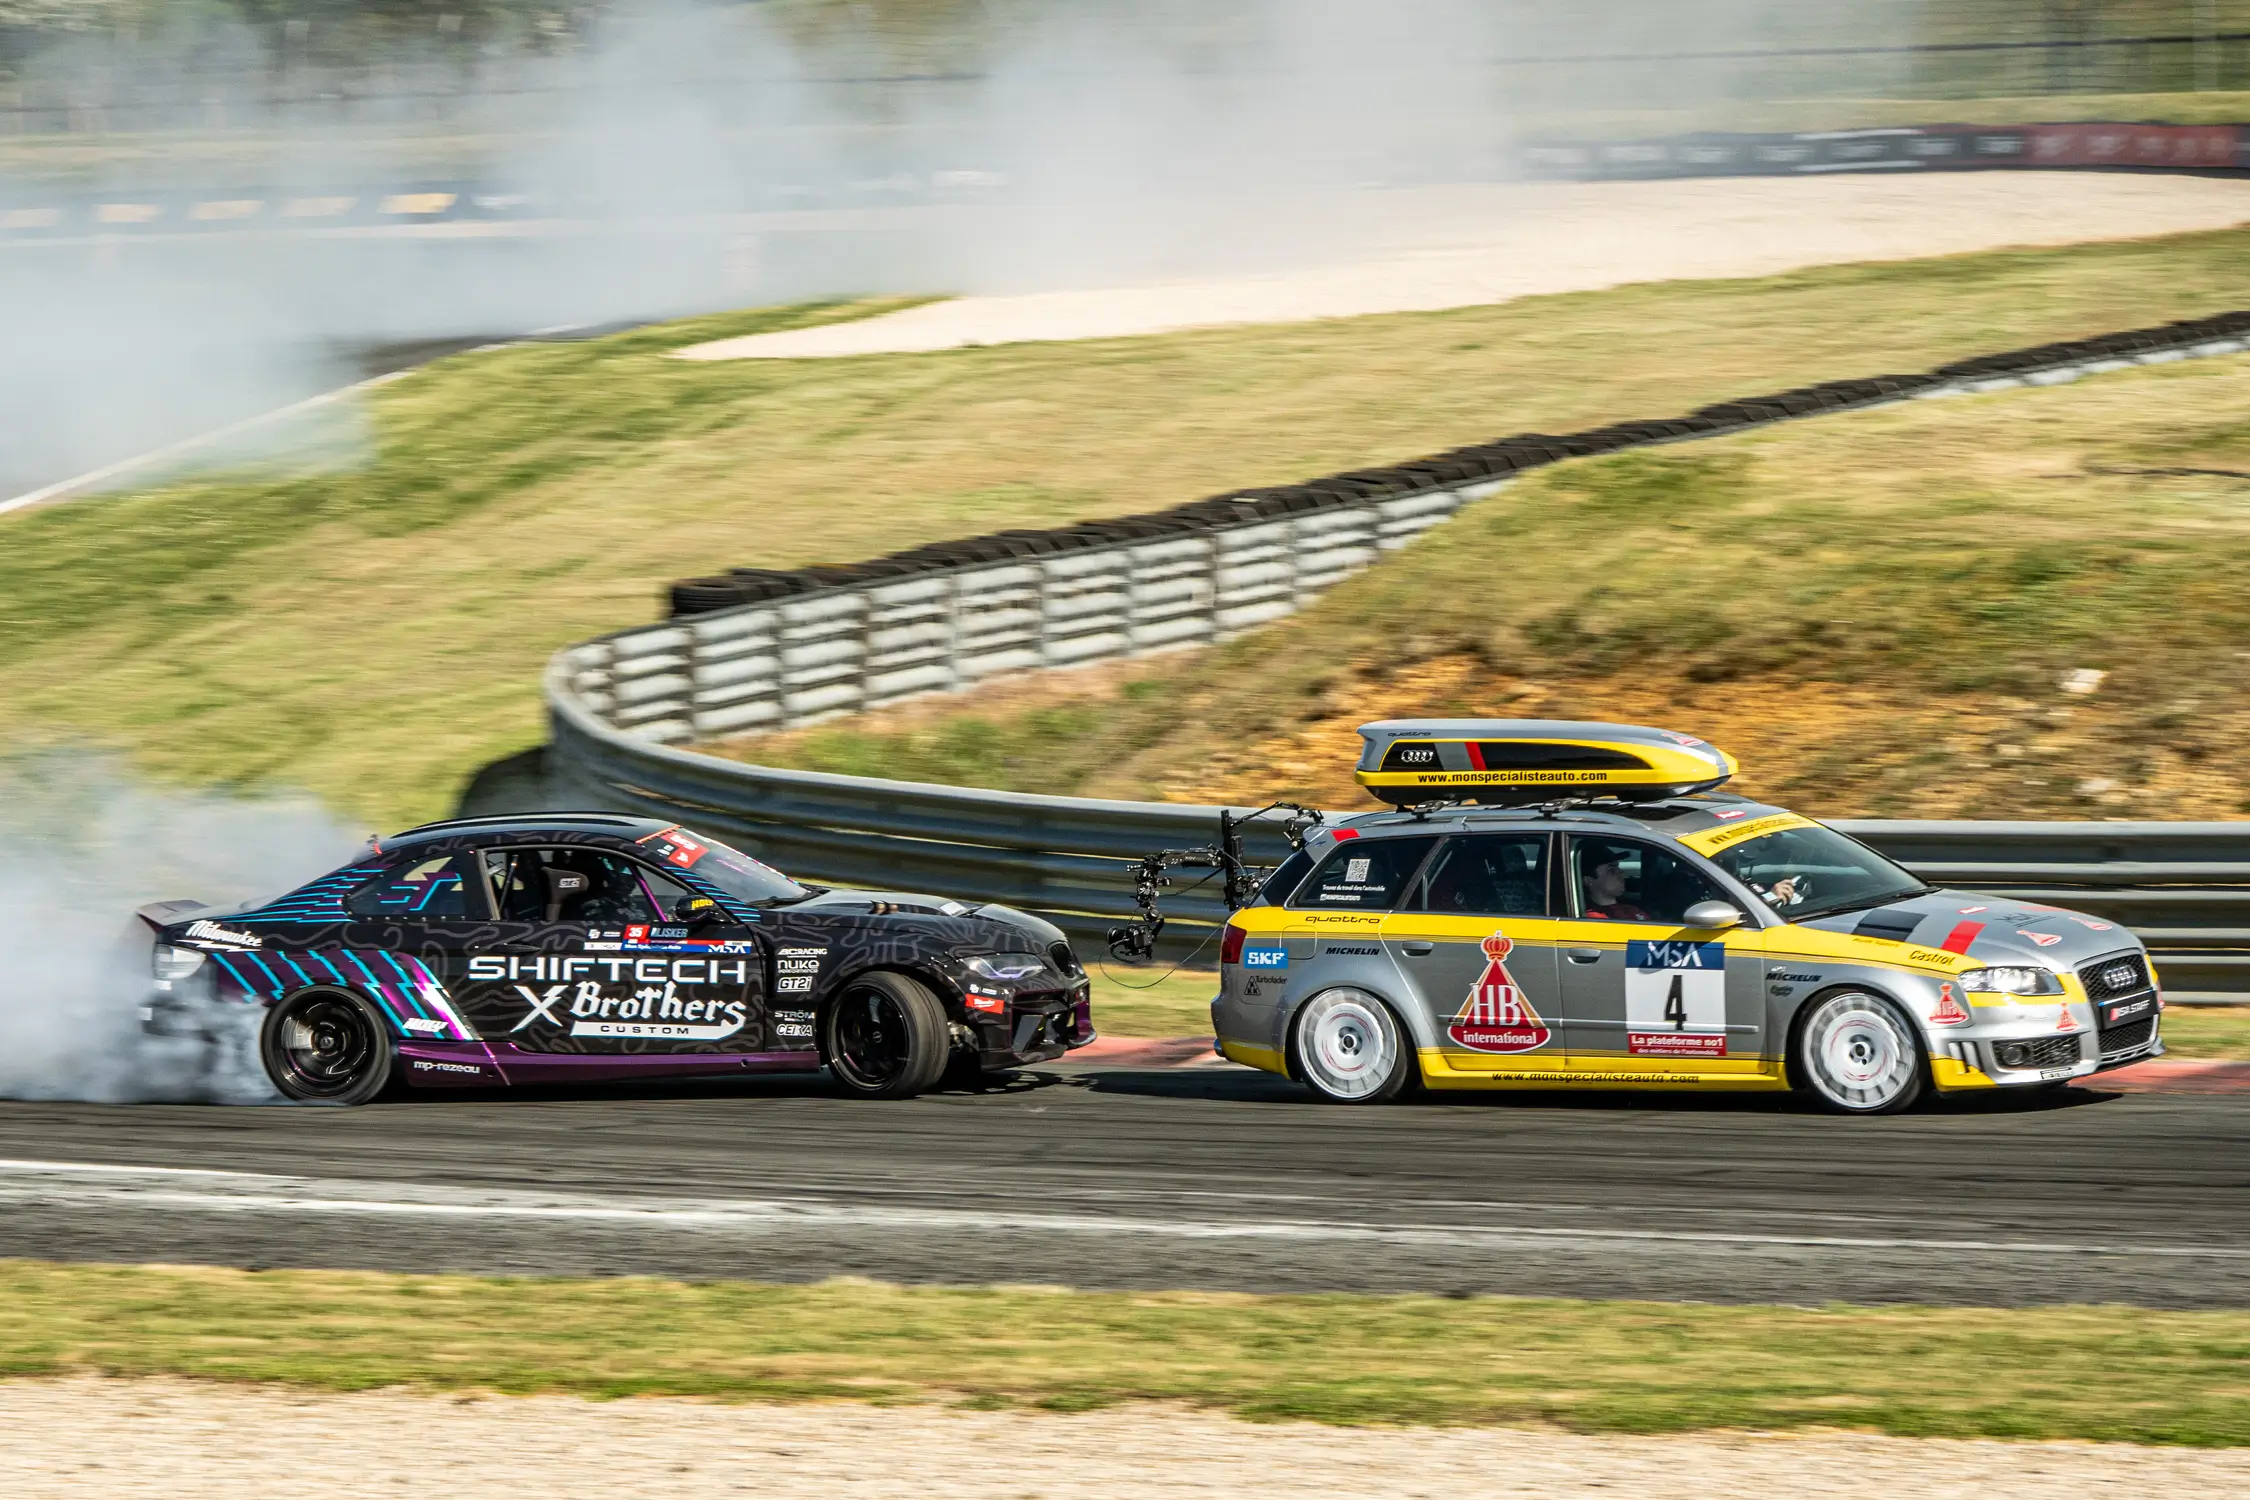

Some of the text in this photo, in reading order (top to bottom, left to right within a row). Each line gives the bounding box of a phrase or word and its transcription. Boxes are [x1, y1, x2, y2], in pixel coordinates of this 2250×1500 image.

[1417, 771, 1607, 783] www.monspecialisteauto.com
[1305, 915, 1380, 924] quattro
[185, 919, 263, 946] Milwaukee
[1325, 947, 1380, 956] MICHELIN
[1647, 941, 1703, 967] MSA
[1909, 950, 1956, 965] Castrol
[777, 959, 819, 969] nuke
[1247, 952, 1285, 965] SKF
[468, 956, 746, 983] SHIFTECH
[779, 976, 812, 989] GT2i
[1255, 975, 1288, 985] Turbolader
[1765, 972, 1823, 982] MICHELIN
[569, 981, 747, 1028] Brothers
[1469, 982, 1521, 1026] HB
[1664, 974, 1688, 1030] 4
[774, 1009, 816, 1019] STRÖM
[600, 1024, 690, 1035] CUSTOM
[1463, 1031, 1537, 1044] international
[1631, 1034, 1723, 1047] La plateforme no1
[413, 1061, 480, 1074] mp-rezeau
[1491, 1072, 1700, 1084] www.monspecialisteauto.com
